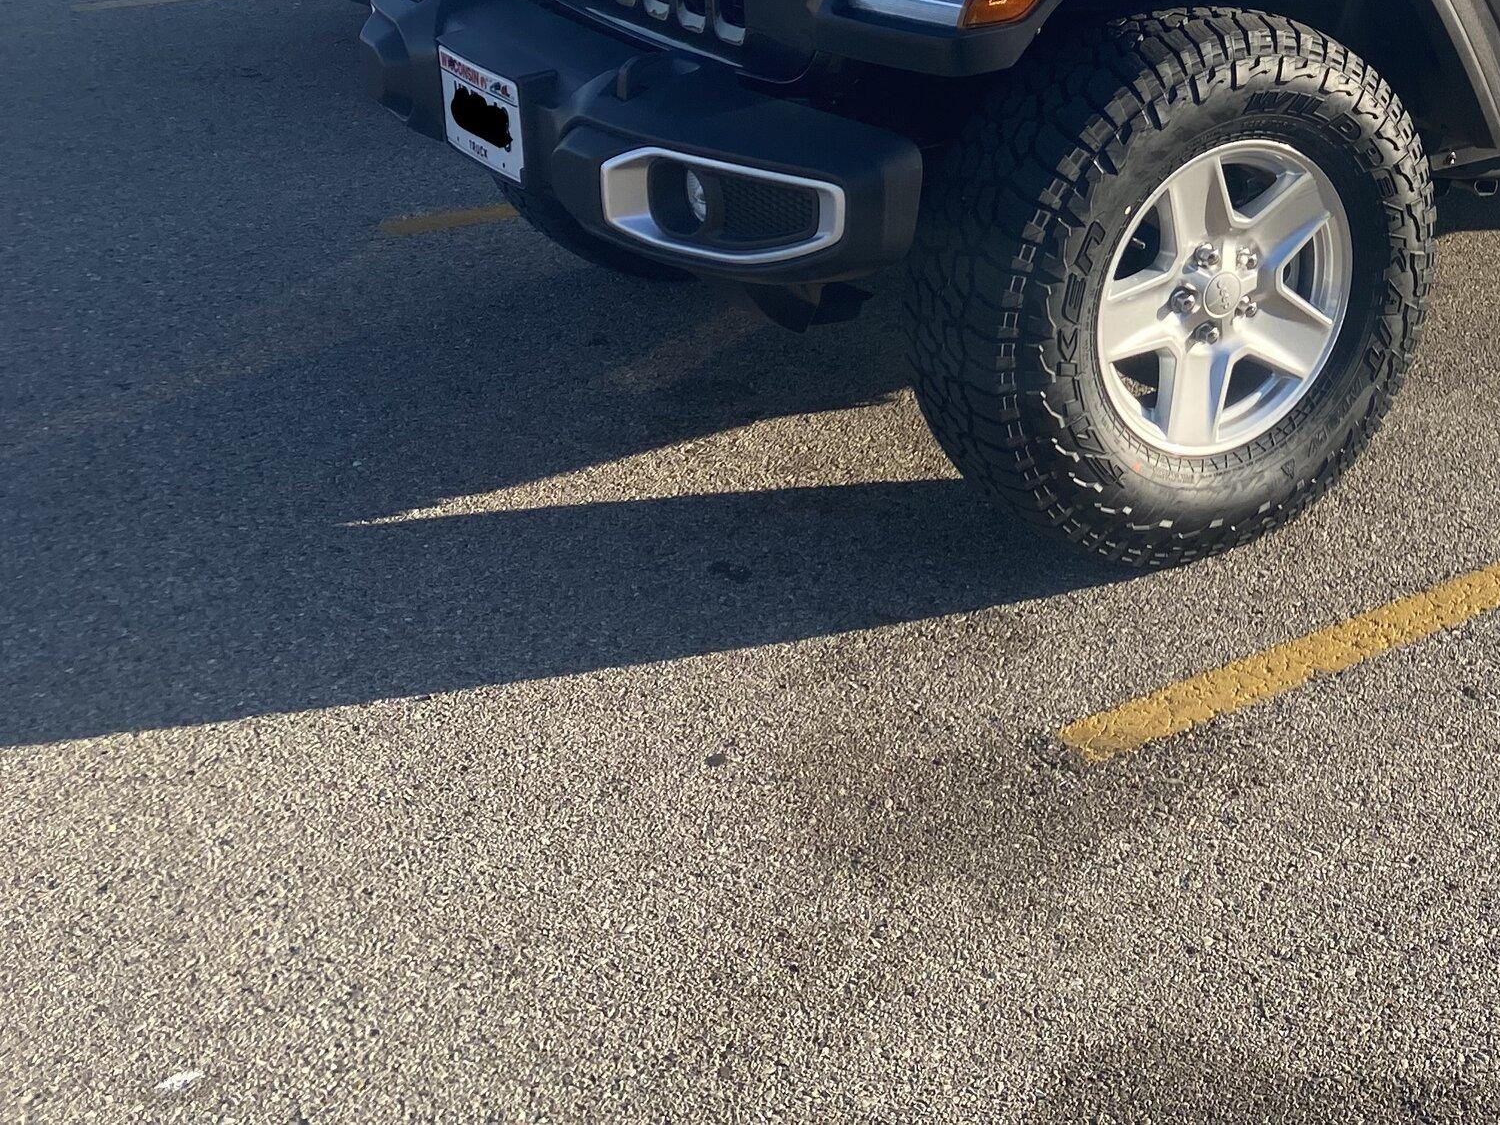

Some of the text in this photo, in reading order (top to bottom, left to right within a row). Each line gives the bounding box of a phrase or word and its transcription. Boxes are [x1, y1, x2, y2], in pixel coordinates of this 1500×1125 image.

[468, 139, 488, 158] TRUCK
[1242, 88, 1407, 273] WILDPEAK
[1056, 219, 1125, 490] FALKEN
